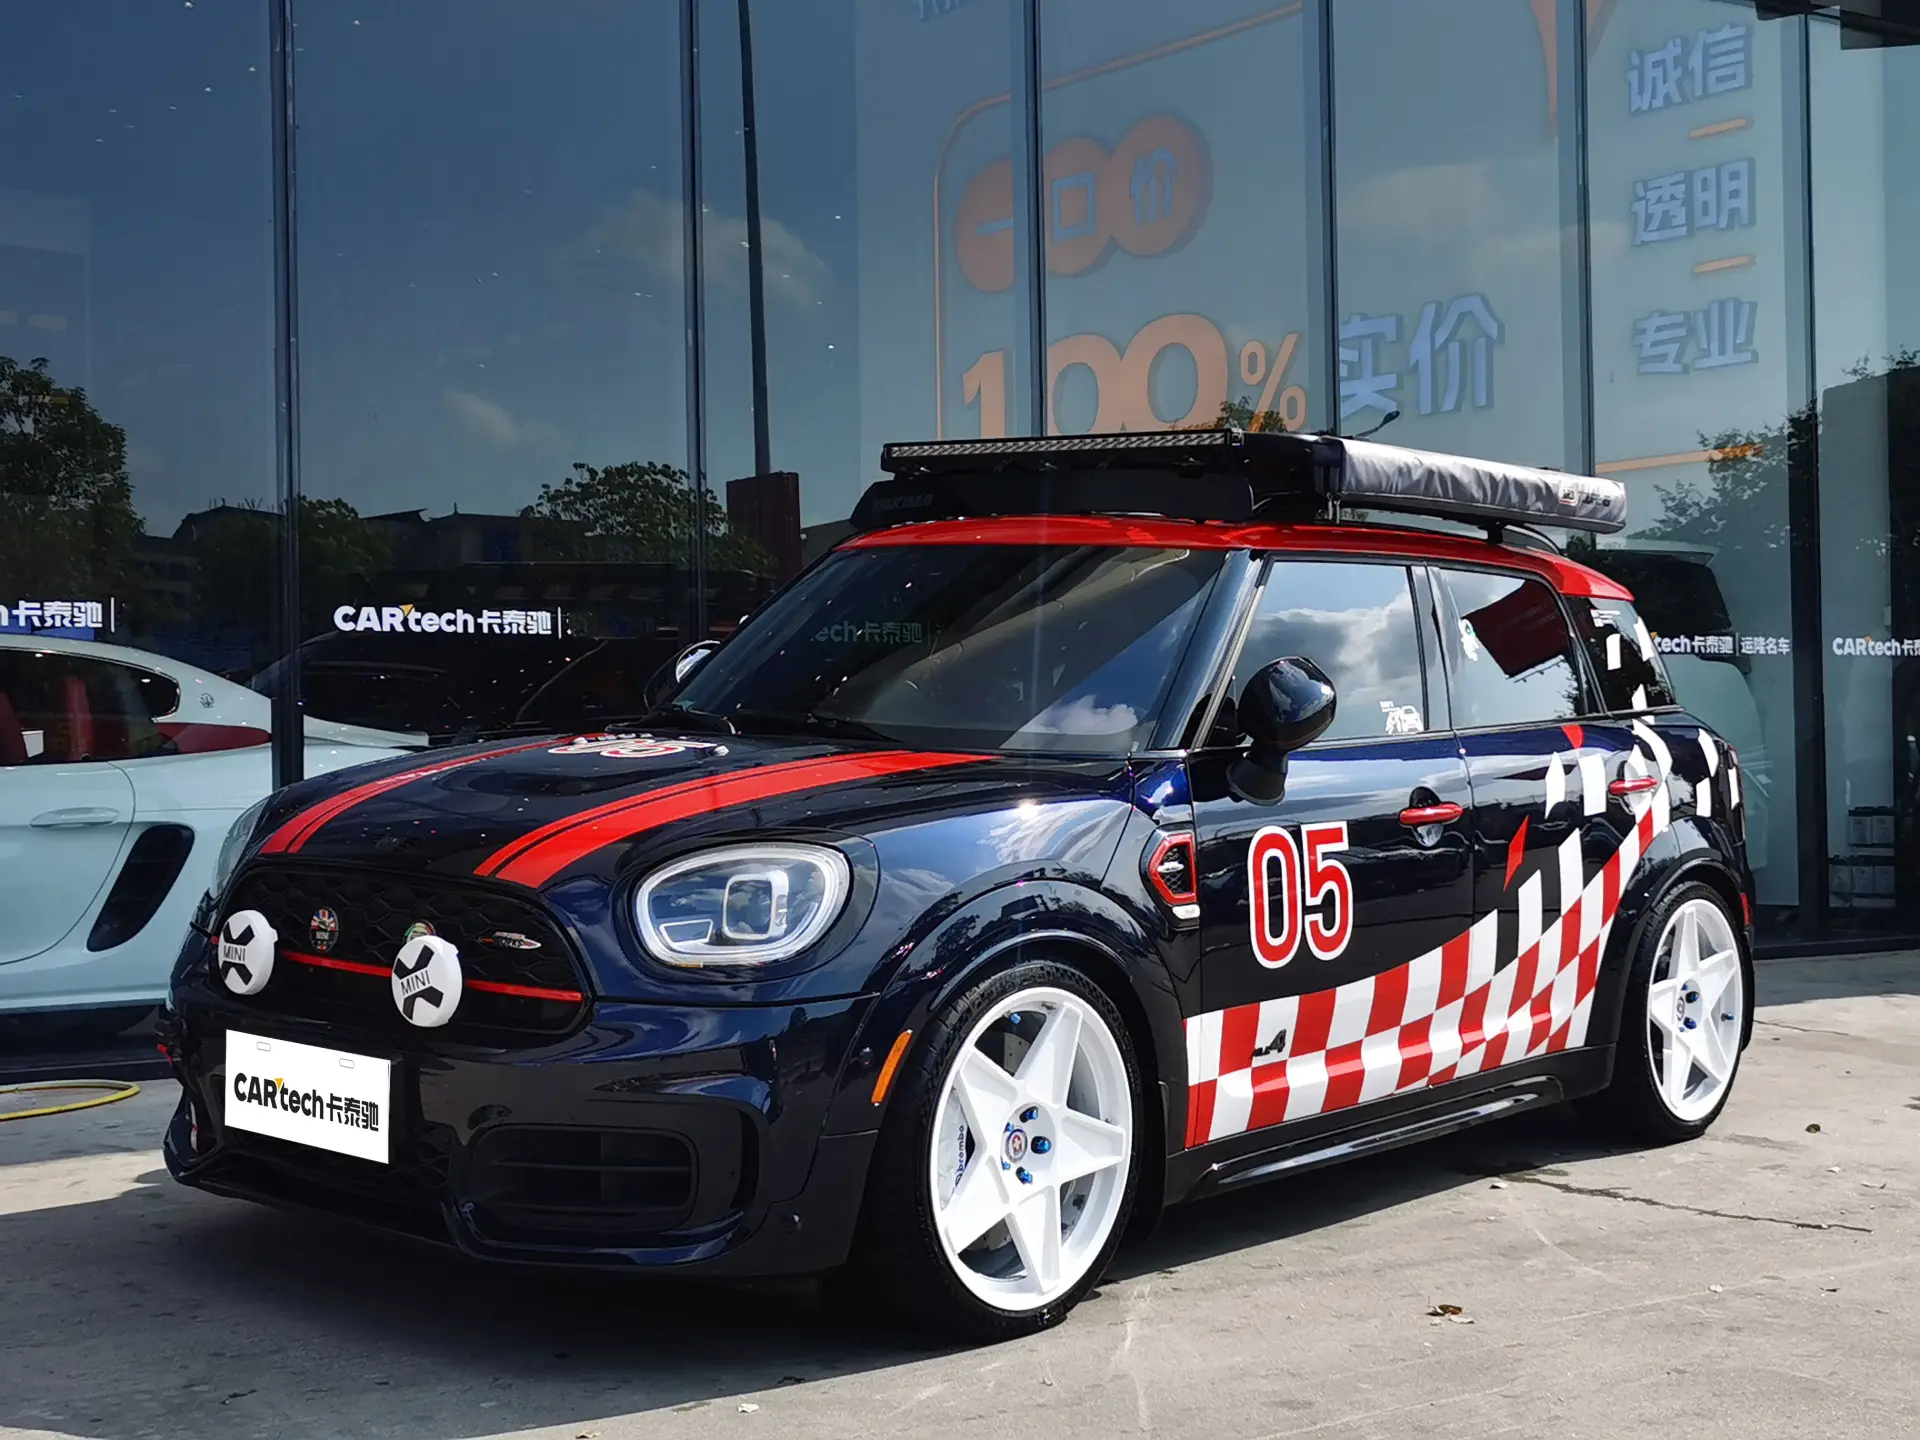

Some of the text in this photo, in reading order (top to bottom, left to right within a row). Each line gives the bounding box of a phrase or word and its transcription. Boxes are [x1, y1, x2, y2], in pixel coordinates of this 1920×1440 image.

[1627, 24, 1750, 112] 诚信
[1631, 158, 1752, 245] 透明
[1633, 299, 1755, 374] 专业
[1339, 293, 1500, 420] 实价
[12, 600, 103, 628] 卡泰驰
[333, 604, 552, 635] CARtech 卡泰驰
[864, 621, 923, 644] 卡泰驰
[1692, 635, 1734, 654] 卡泰驰
[1741, 636, 1791, 655] 运隆名车
[1832, 636, 1901, 656] CARtech
[1247, 821, 1354, 969] 05
[223, 944, 246, 962] MINI
[400, 970, 431, 996] MINI
[234, 1072, 379, 1132] CARtech 卡泰驰
